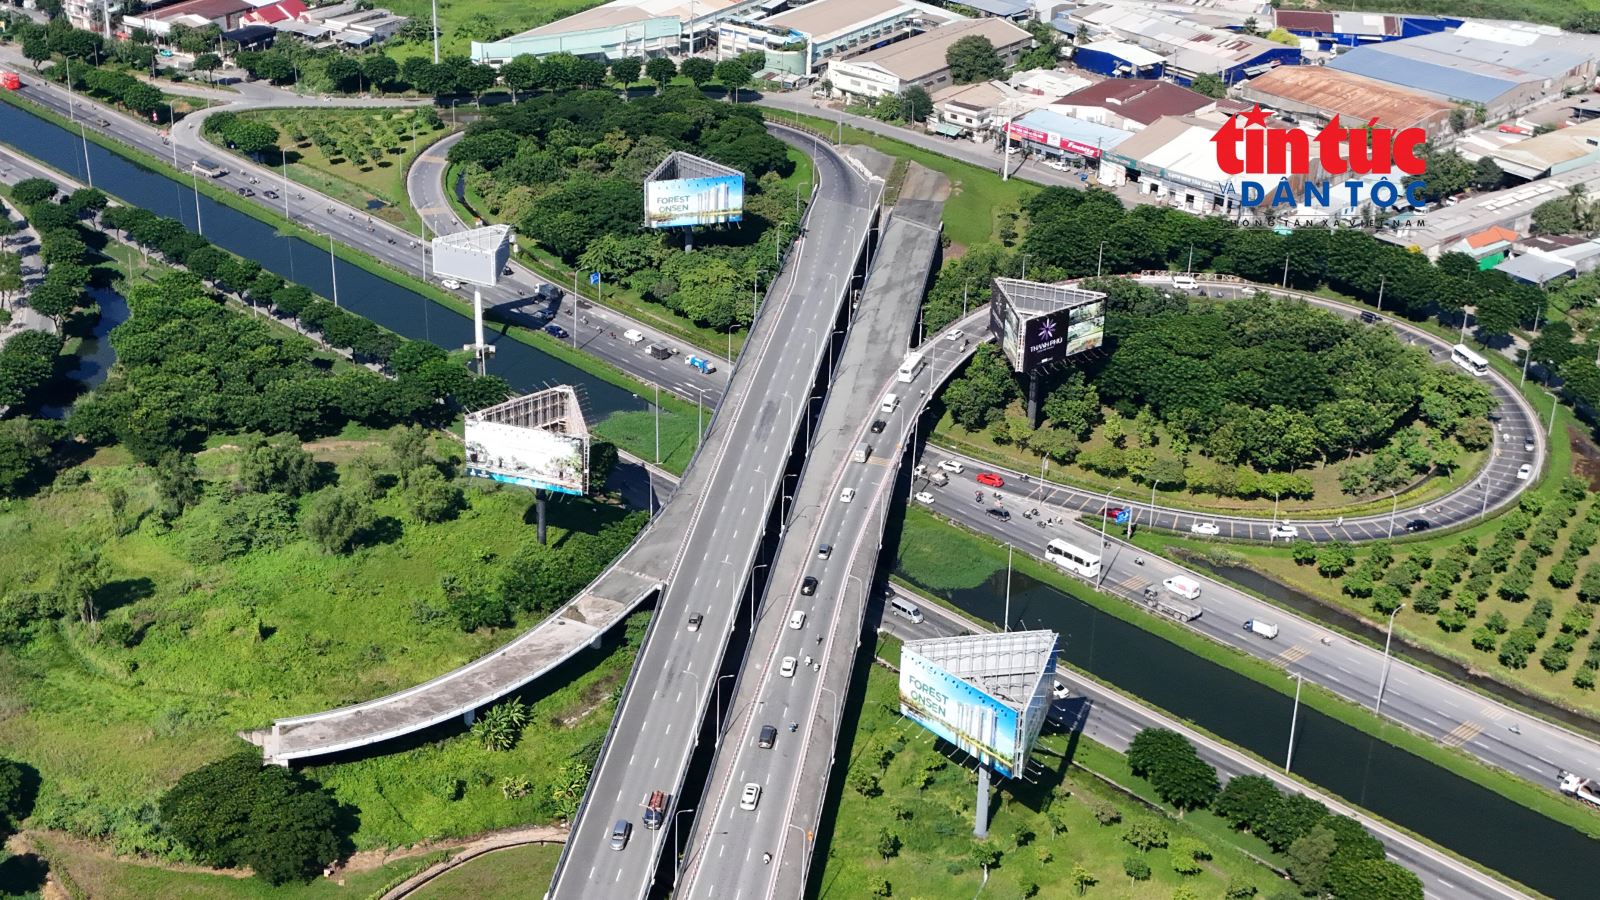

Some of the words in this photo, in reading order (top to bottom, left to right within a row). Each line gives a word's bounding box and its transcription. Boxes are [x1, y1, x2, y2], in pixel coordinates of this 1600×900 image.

[657, 195, 690, 204] FOREST
[659, 204, 688, 212] ONSEN
[909, 675, 949, 705] FOREST
[910, 690, 946, 717] ONSEN
